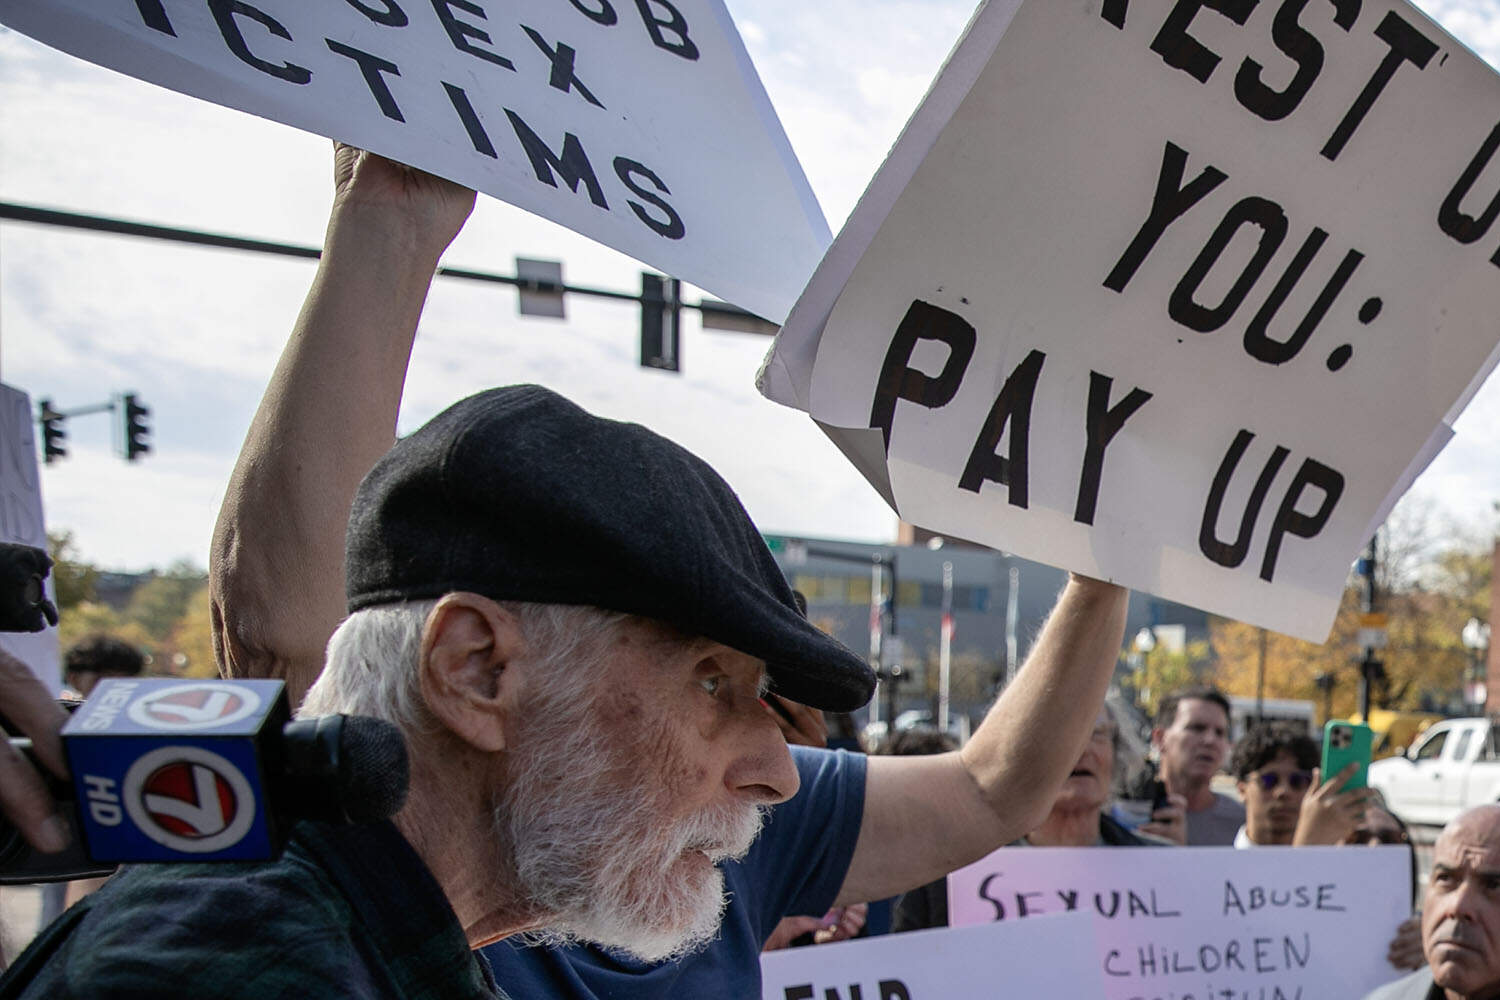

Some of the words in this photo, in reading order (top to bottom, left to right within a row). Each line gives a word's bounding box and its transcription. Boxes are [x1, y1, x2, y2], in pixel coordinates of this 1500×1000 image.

[1098, 0, 1440, 162] EST
[1101, 140, 1384, 372] YOU:
[869, 298, 1154, 527] PAY
[1198, 428, 1346, 584] UP
[80, 681, 140, 731] NEWS
[82, 773, 123, 827] HD
[978, 872, 1182, 923] SEXUAL
[1222, 879, 1347, 917] ABUSE
